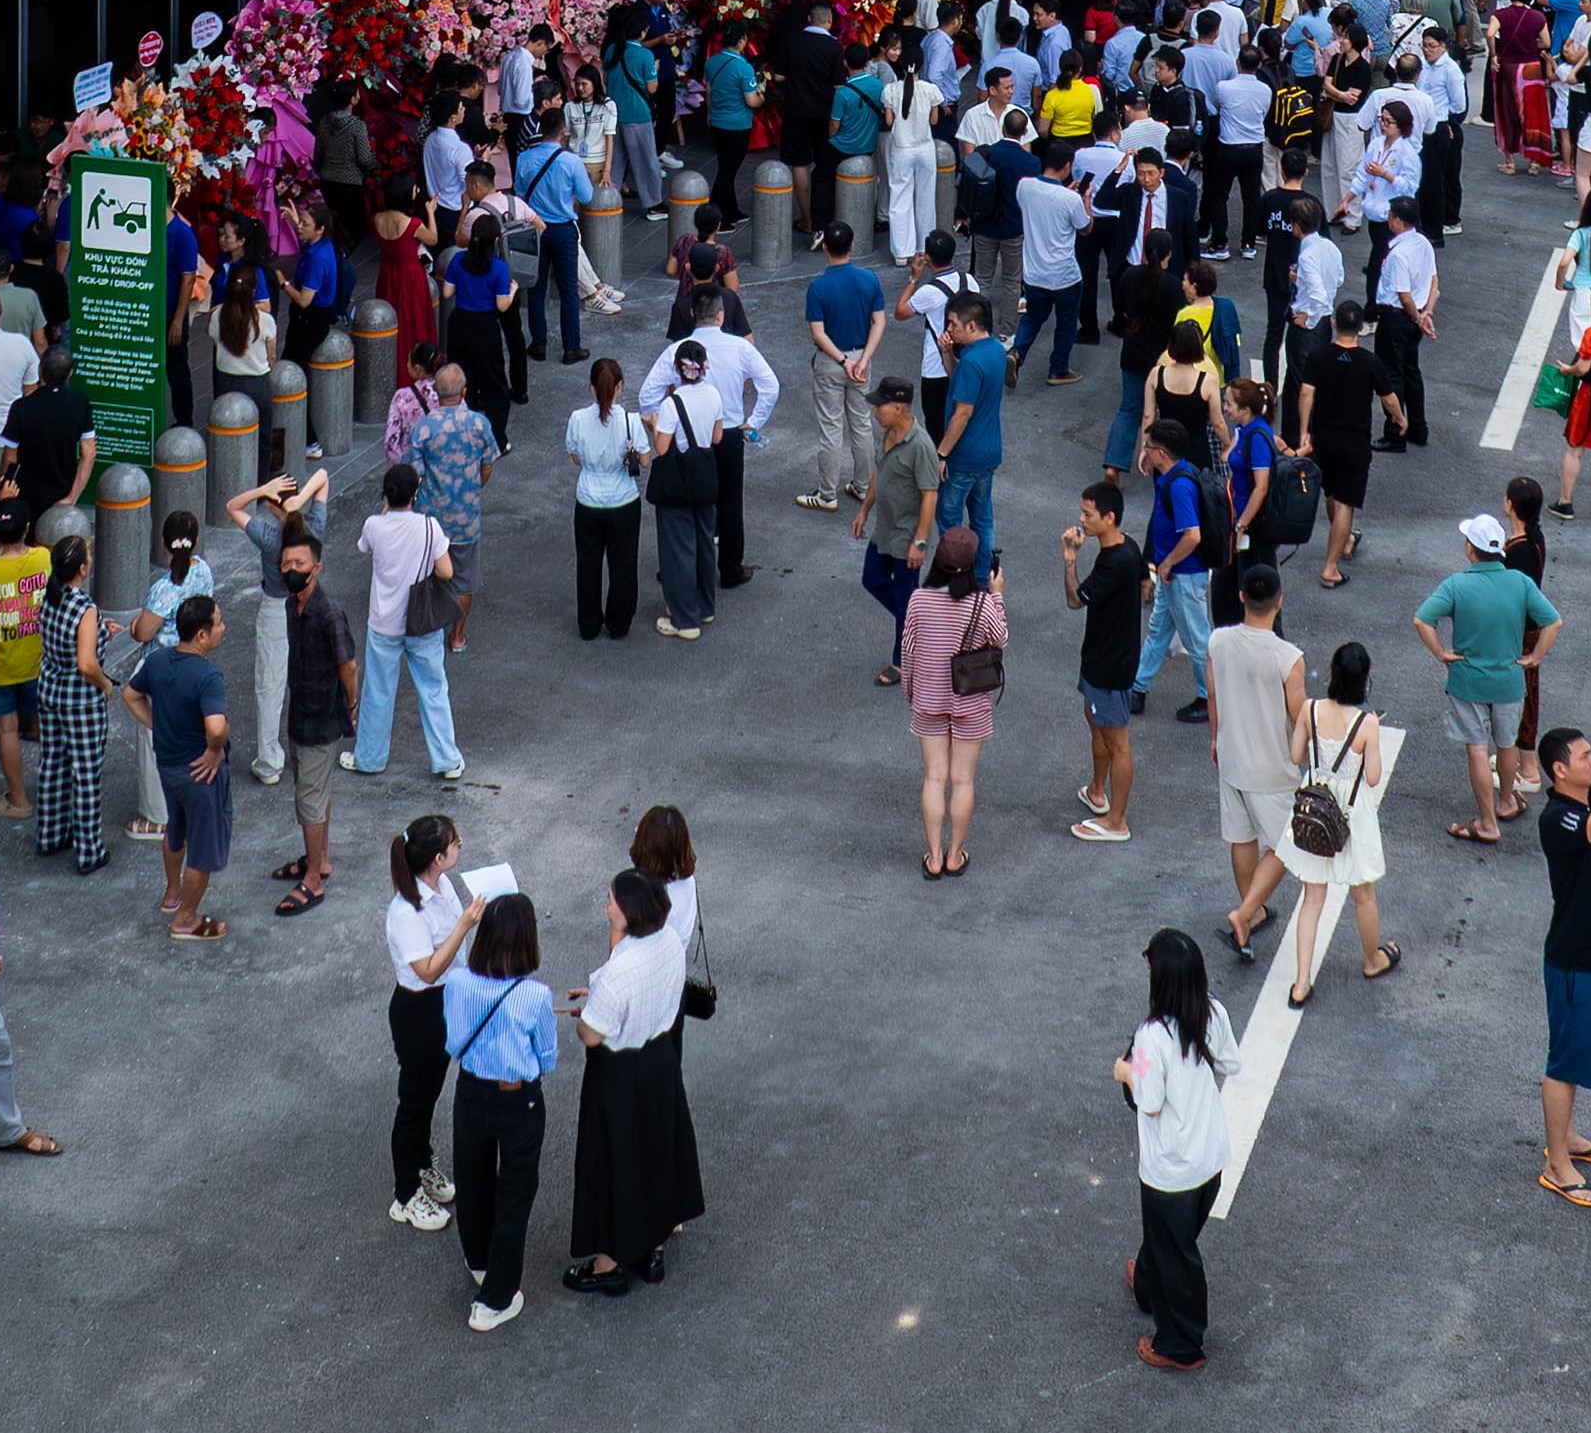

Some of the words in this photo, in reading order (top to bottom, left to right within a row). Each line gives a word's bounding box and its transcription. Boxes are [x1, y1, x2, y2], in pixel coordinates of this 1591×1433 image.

[85, 253, 103, 262] KHU
[105, 254, 124, 265] VỰC
[110, 266, 142, 277] KHÁCH
[78, 275, 109, 285] PICK-UP
[114, 279, 155, 291] DROP-OFF
